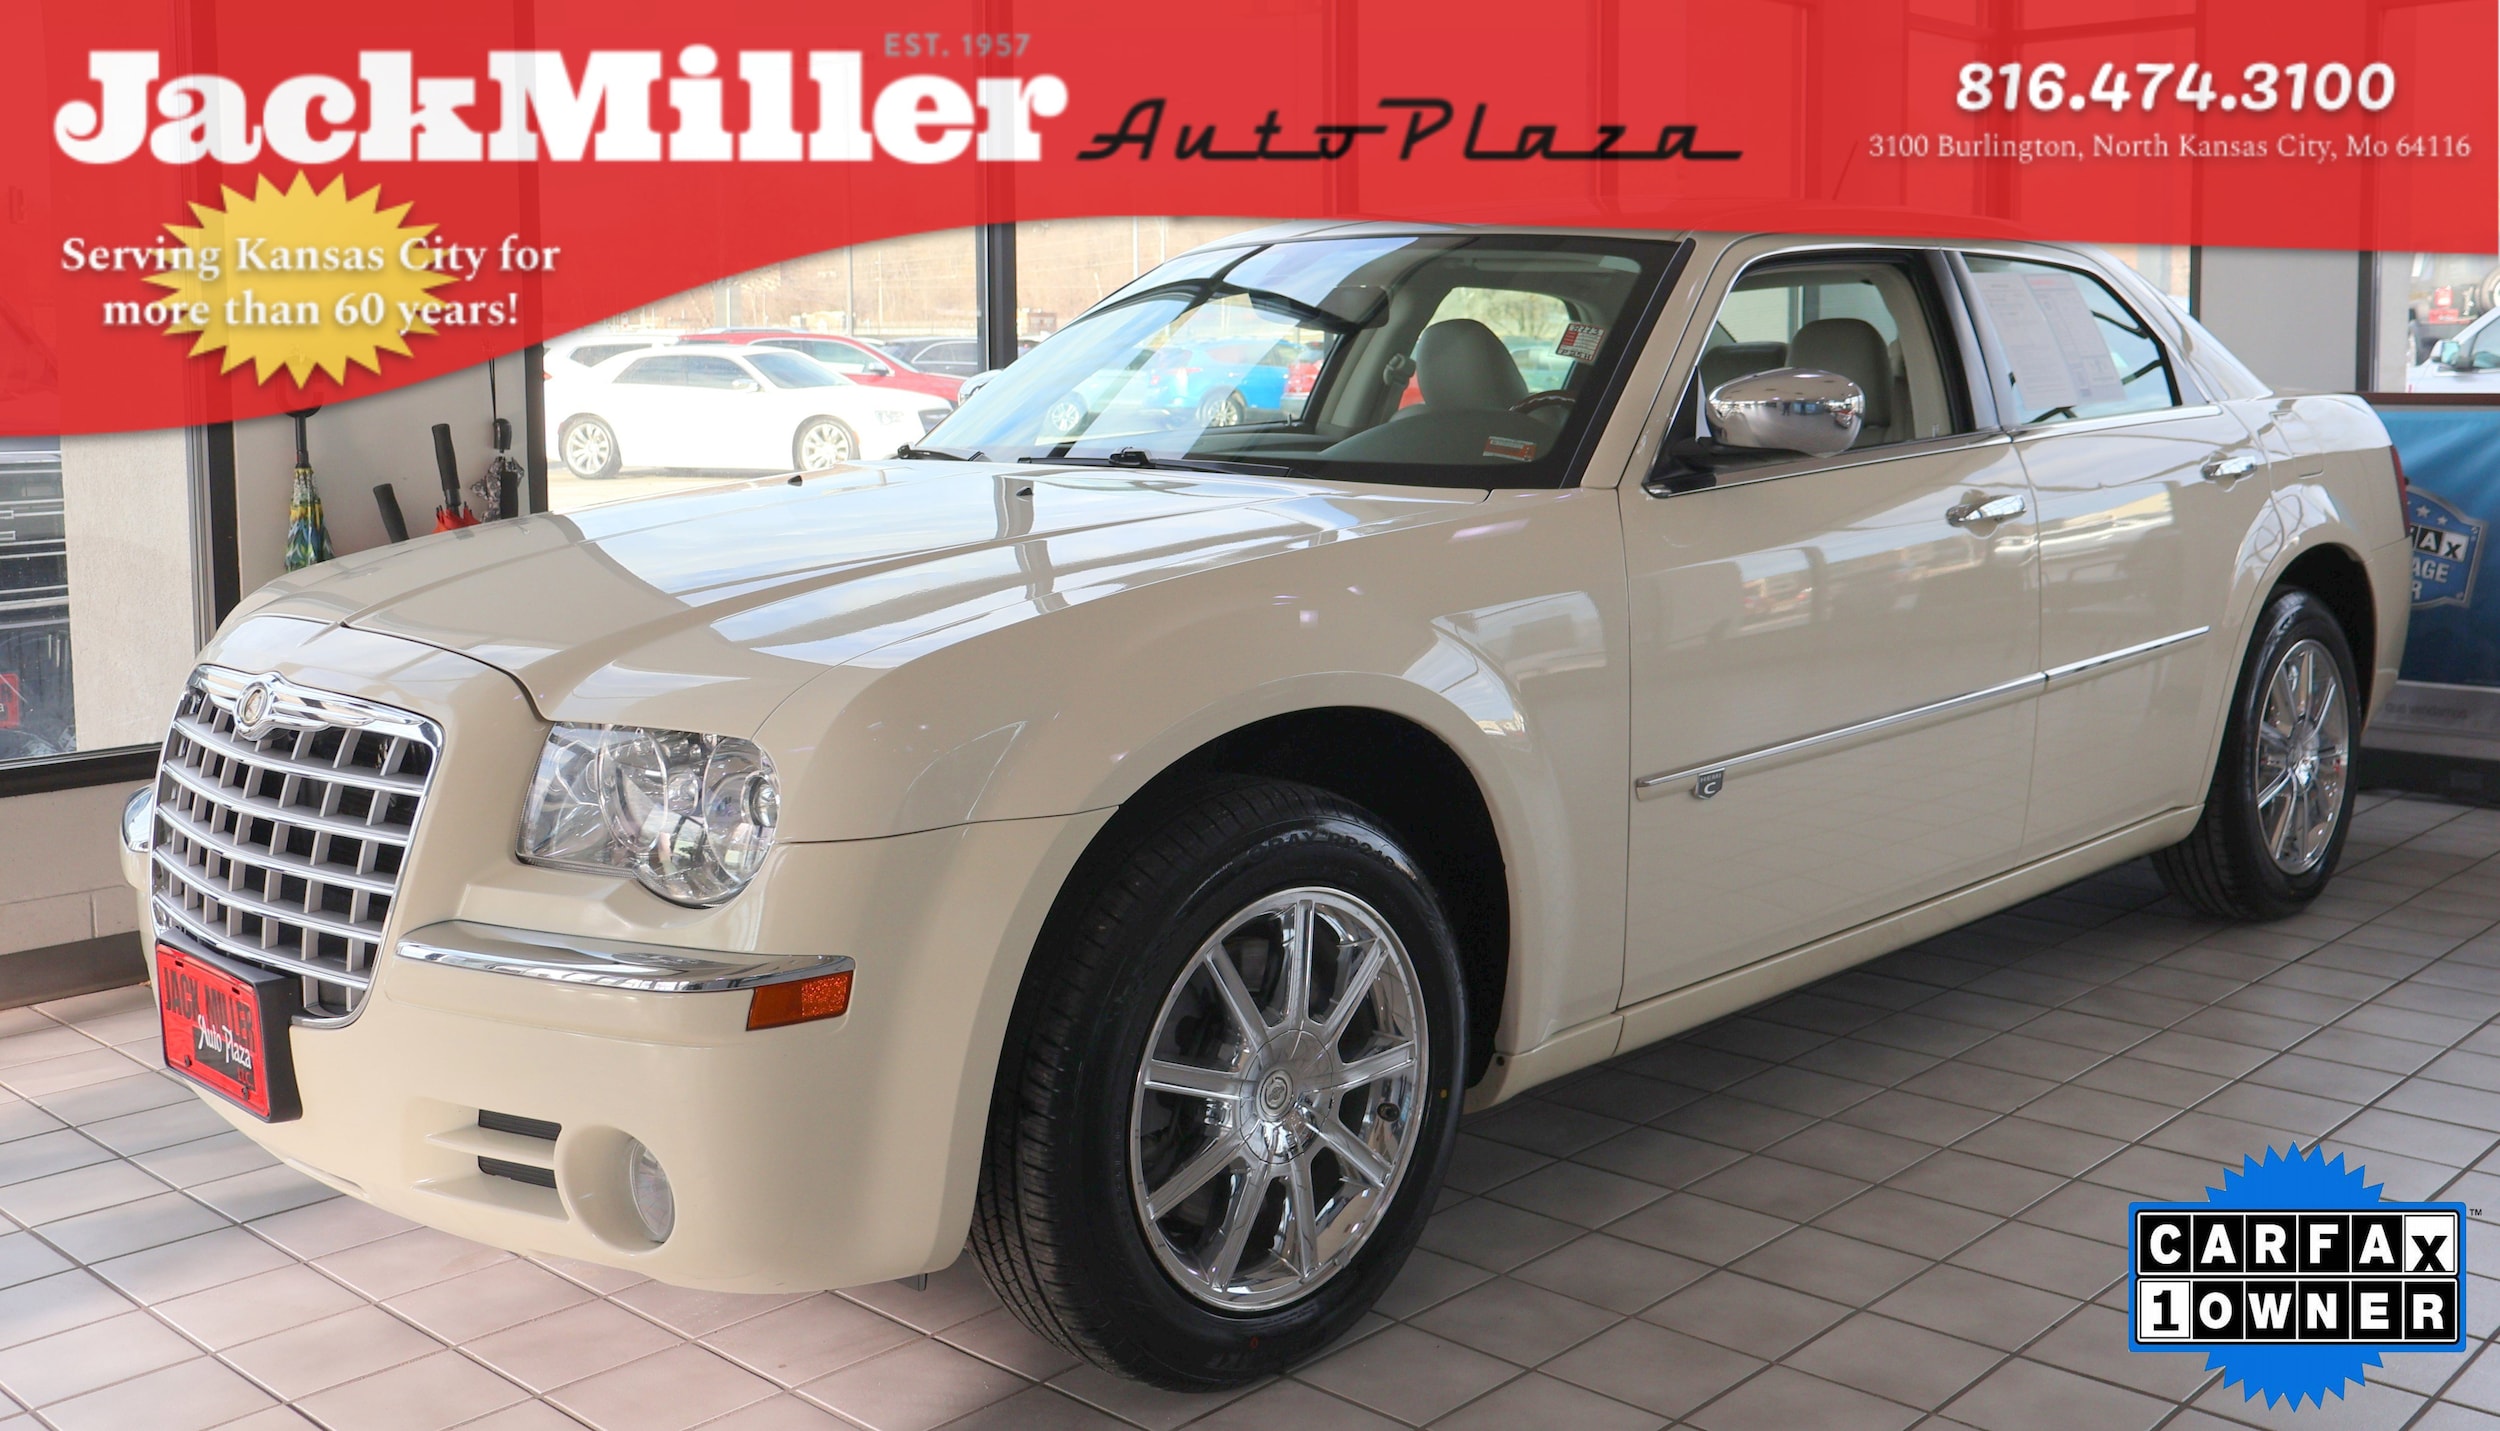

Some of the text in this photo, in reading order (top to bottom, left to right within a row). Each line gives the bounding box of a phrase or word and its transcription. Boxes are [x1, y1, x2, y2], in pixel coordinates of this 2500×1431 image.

[165, 968, 255, 1054] JACK MILLER
[198, 1014, 252, 1069] Auto Plaza
